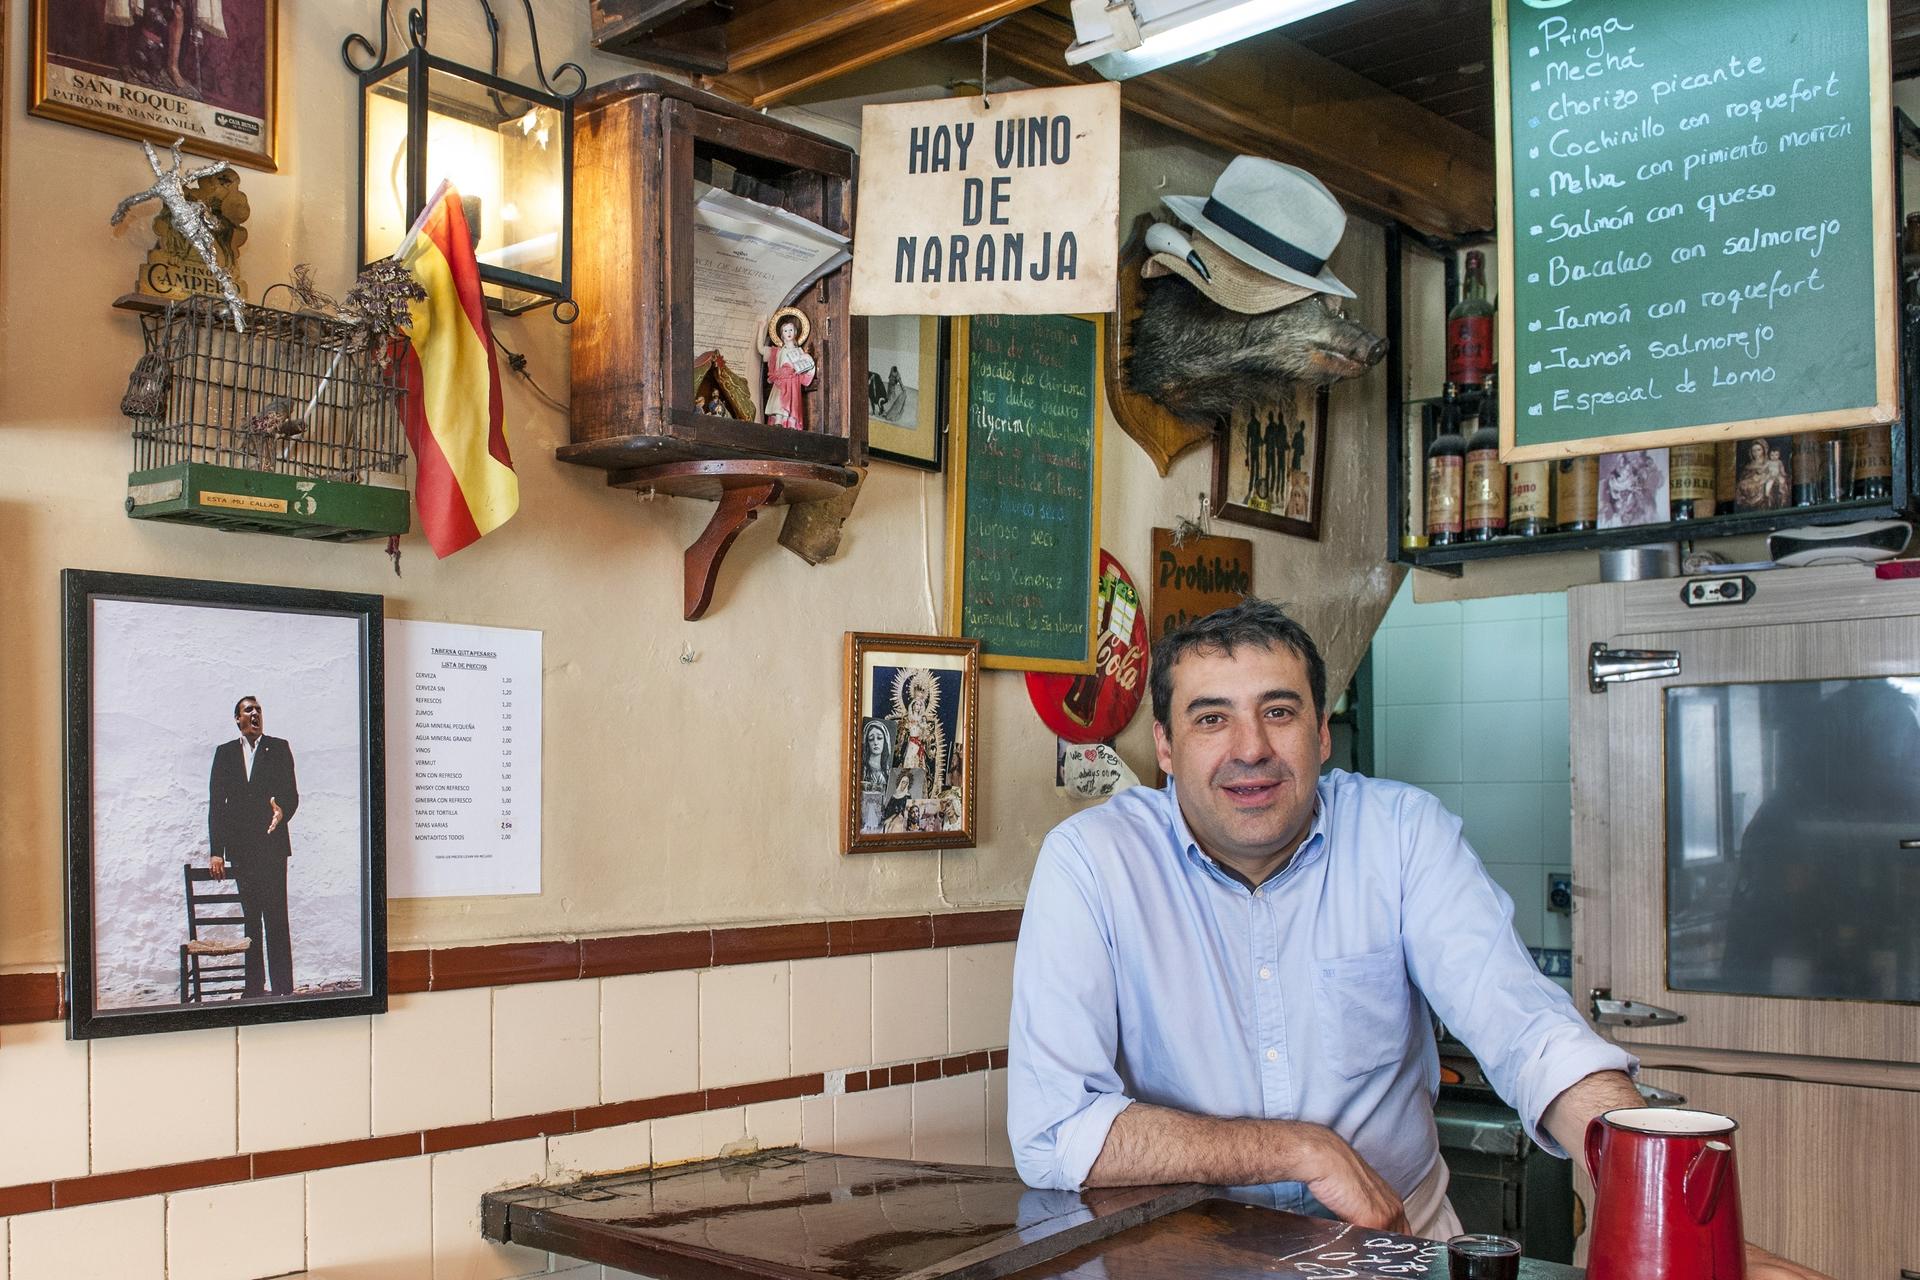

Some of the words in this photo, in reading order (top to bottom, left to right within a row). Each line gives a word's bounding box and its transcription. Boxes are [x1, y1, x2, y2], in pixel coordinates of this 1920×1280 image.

[72, 74, 112, 96] SAN
[119, 86, 188, 116] ROQUE
[1651, 56, 1766, 104] picante
[52, 88, 103, 109] PATRON
[107, 102, 123, 113] DE
[127, 106, 207, 135] MANZANILLA
[1549, 116, 1665, 157] Cochinillo
[1679, 112, 1710, 130] con
[1726, 72, 1840, 122] roquefort
[909, 122, 975, 174] HAY
[994, 115, 1071, 168] VINO
[1549, 165, 1626, 196] Melva
[1637, 158, 1673, 180] con
[1684, 135, 1768, 180] pimiento
[963, 176, 1012, 226] DE
[1546, 205, 1634, 243] Salmón
[1646, 203, 1684, 223] con
[1697, 184, 1776, 222] queso
[895, 231, 1078, 283] NARANJA
[1549, 251, 1652, 287] Bacalao
[1671, 243, 1706, 264] con
[1723, 219, 1841, 258] salmorejo
[1648, 298, 1686, 319] con
[1701, 268, 1825, 314] roquefort
[1021, 365, 1036, 385] de
[1675, 367, 1697, 393] de
[1712, 365, 1777, 387] Lomo
[206, 496, 228, 504] ESTA
[249, 501, 280, 510] CALLAO
[293, 481, 318, 516] 3
[968, 513, 1019, 540] Oloroso
[441, 661, 457, 669] LISTA
[466, 663, 488, 671] PRECIOS
[1096, 629, 1145, 690] Cola
[453, 722, 476, 731] PEQUEÑA
